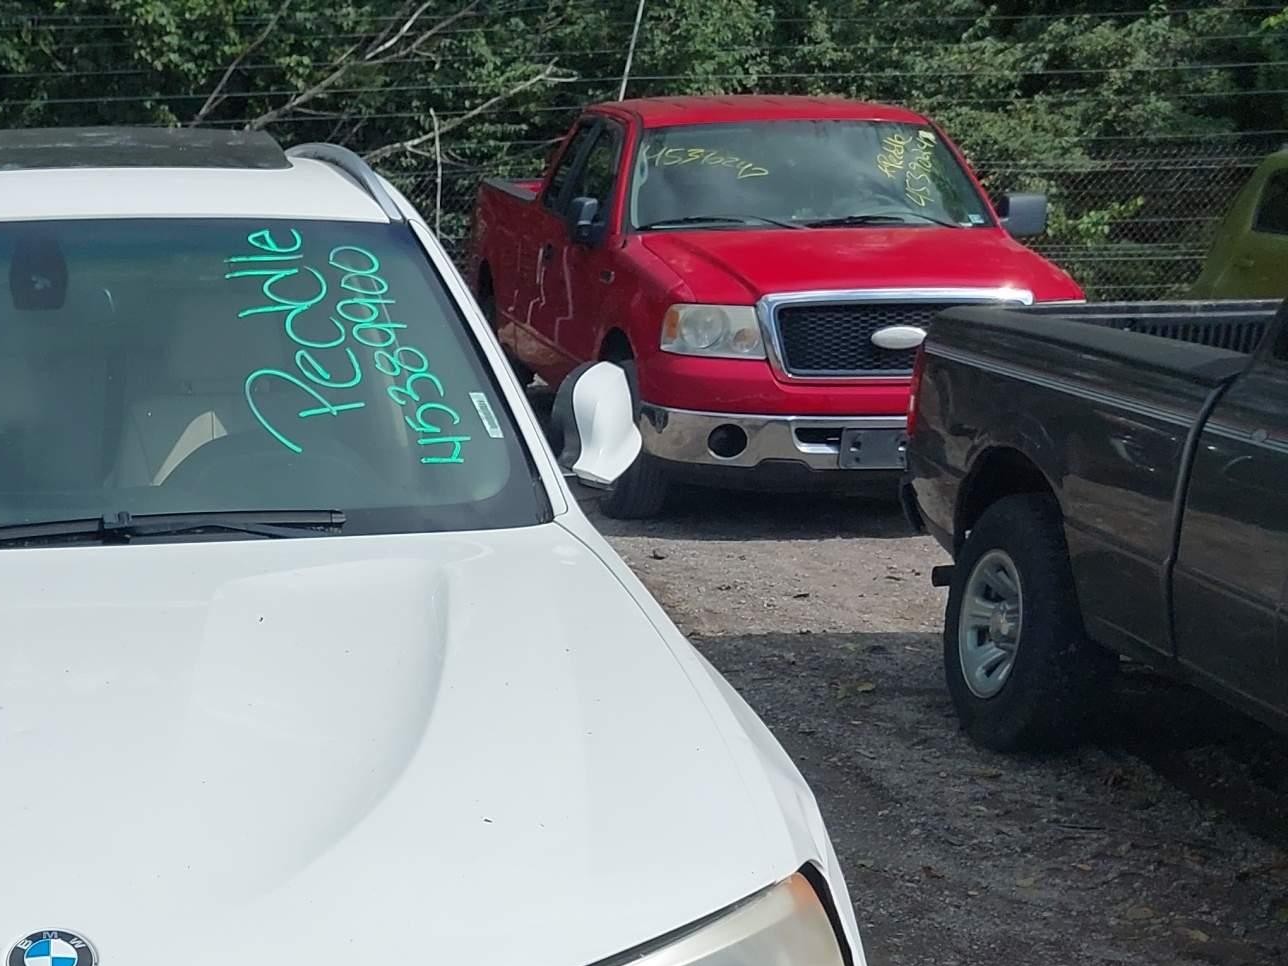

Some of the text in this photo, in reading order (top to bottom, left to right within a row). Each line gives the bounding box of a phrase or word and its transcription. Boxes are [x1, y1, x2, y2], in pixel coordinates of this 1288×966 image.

[224, 228, 365, 453] Peddle
[329, 246, 471, 464] 45389900
[17, 931, 86, 950] BMW
